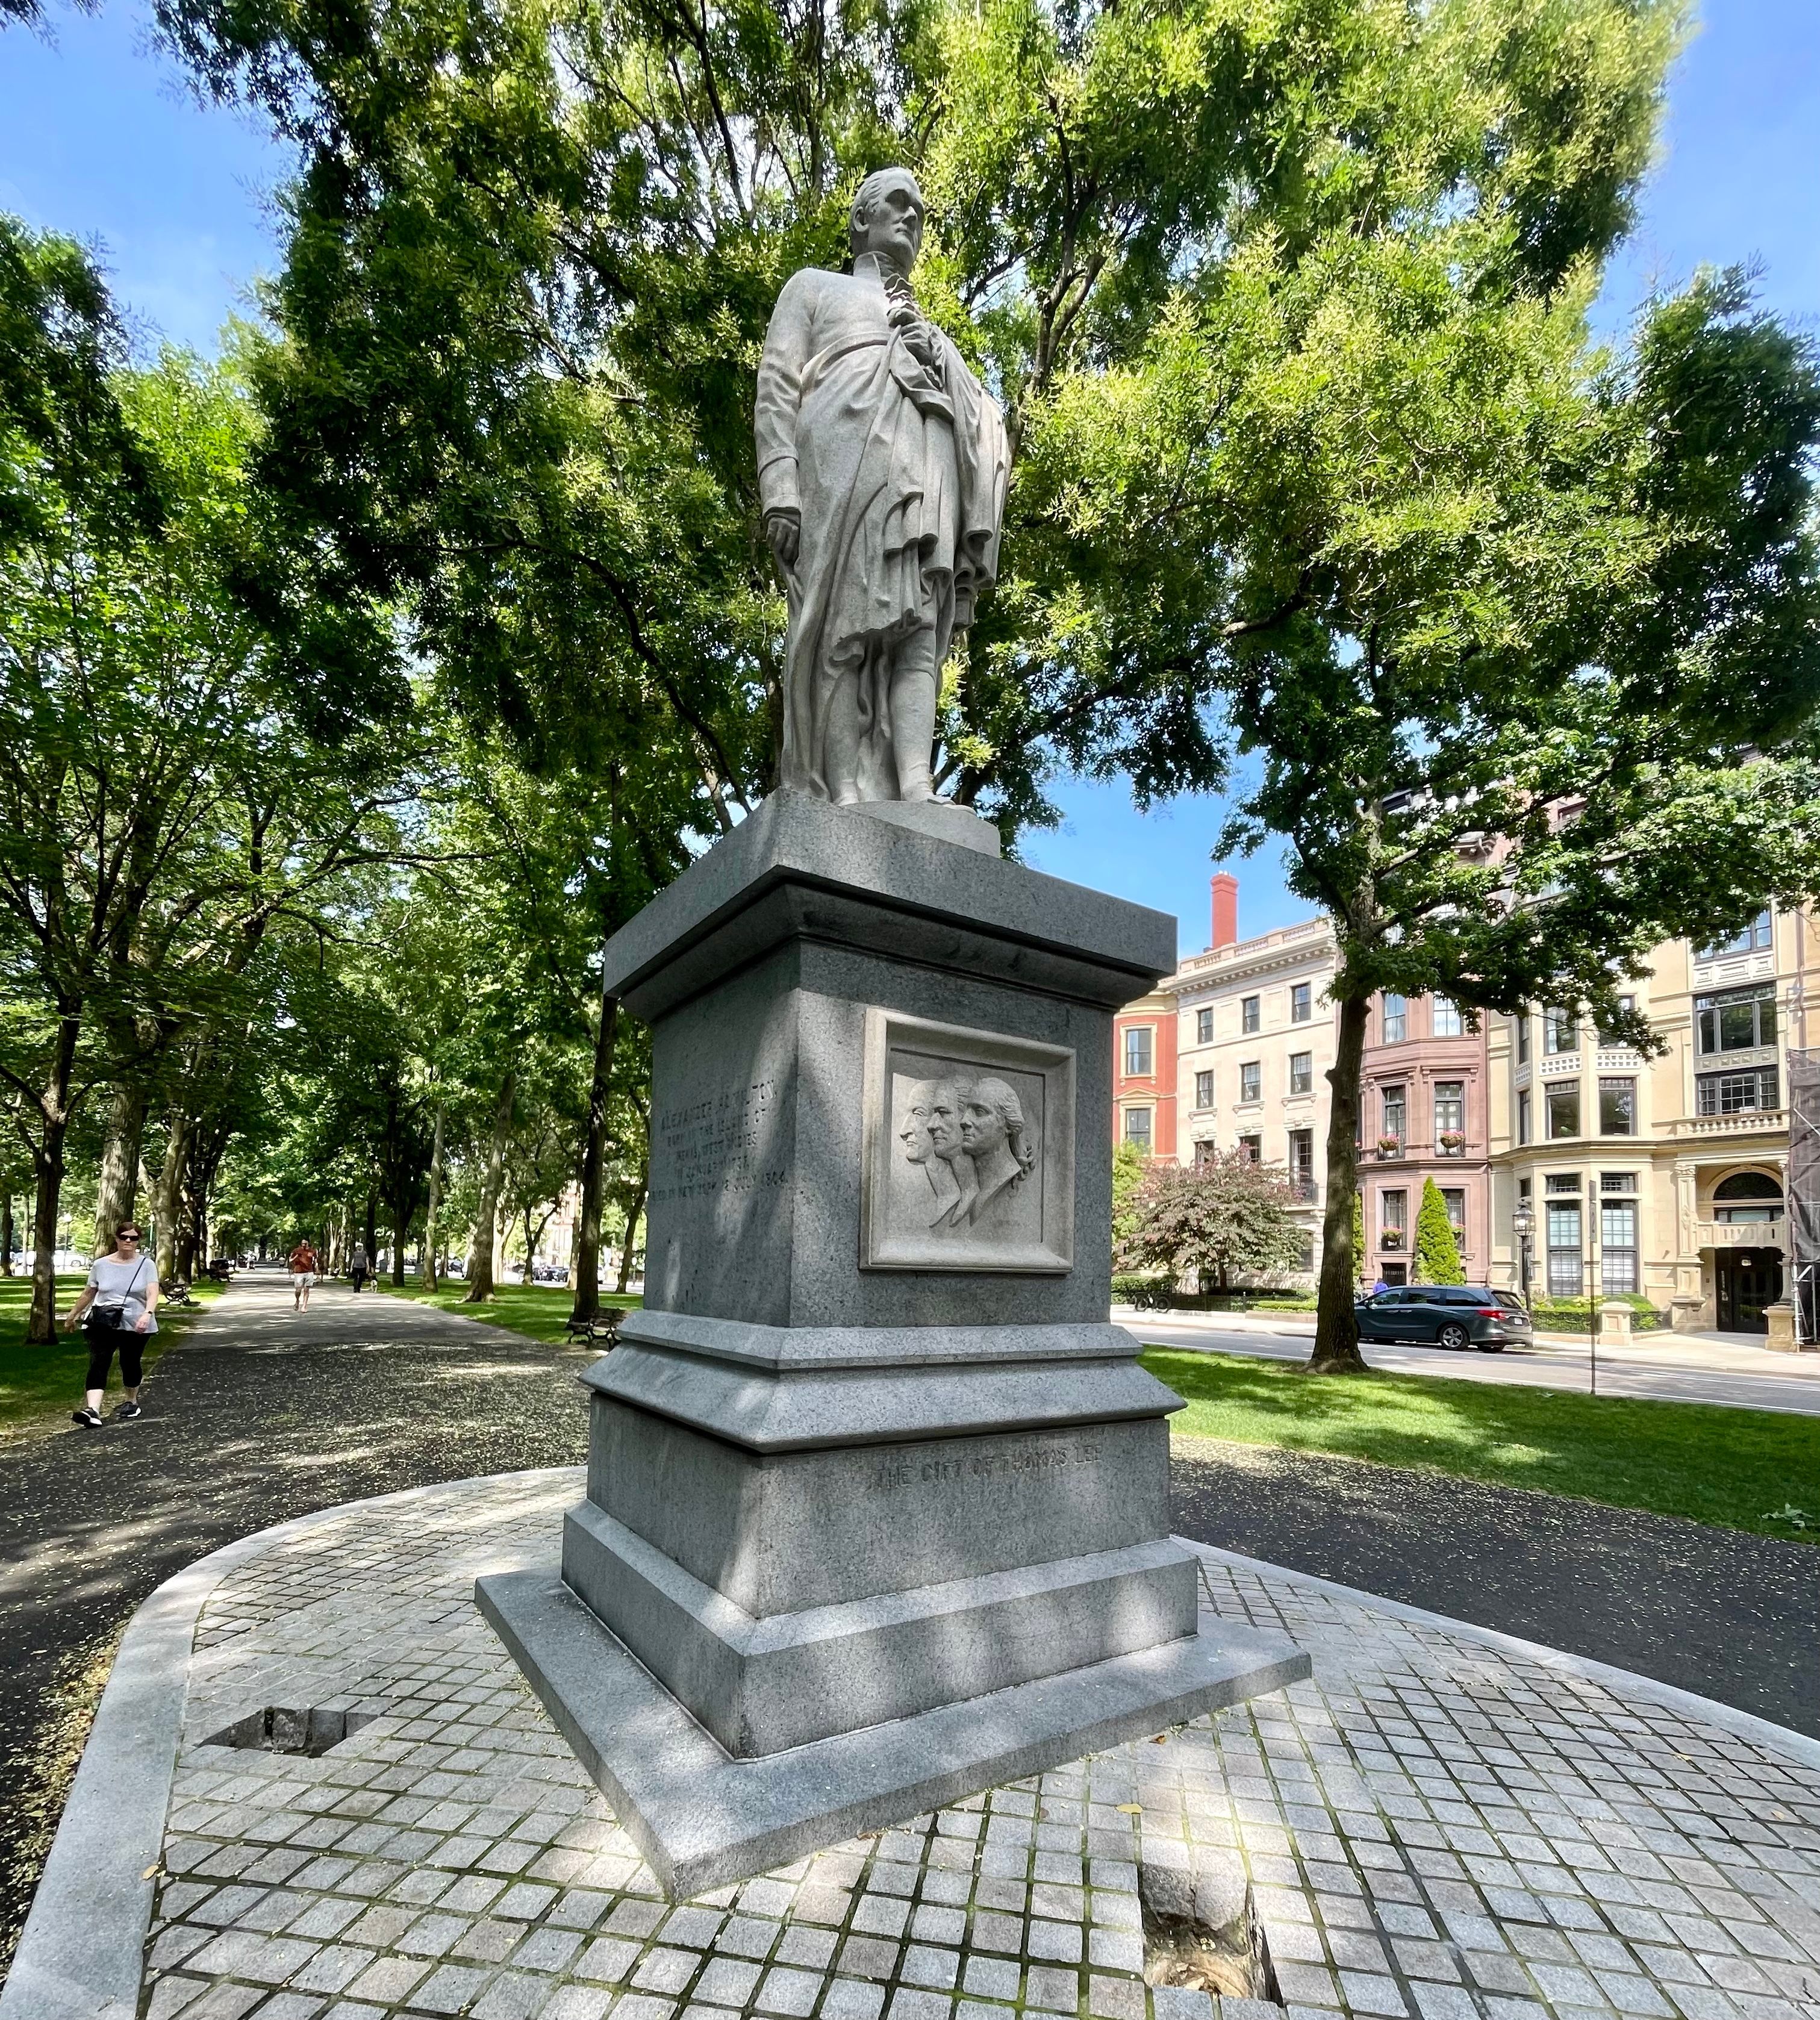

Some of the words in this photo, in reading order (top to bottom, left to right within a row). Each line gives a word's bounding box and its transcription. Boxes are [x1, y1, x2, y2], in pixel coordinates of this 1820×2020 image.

[876, 1465, 913, 1489] THE
[971, 1456, 994, 1477] OF
[1001, 1448, 1068, 1475] THOMAS
[1074, 1445, 1103, 1465] LEE
